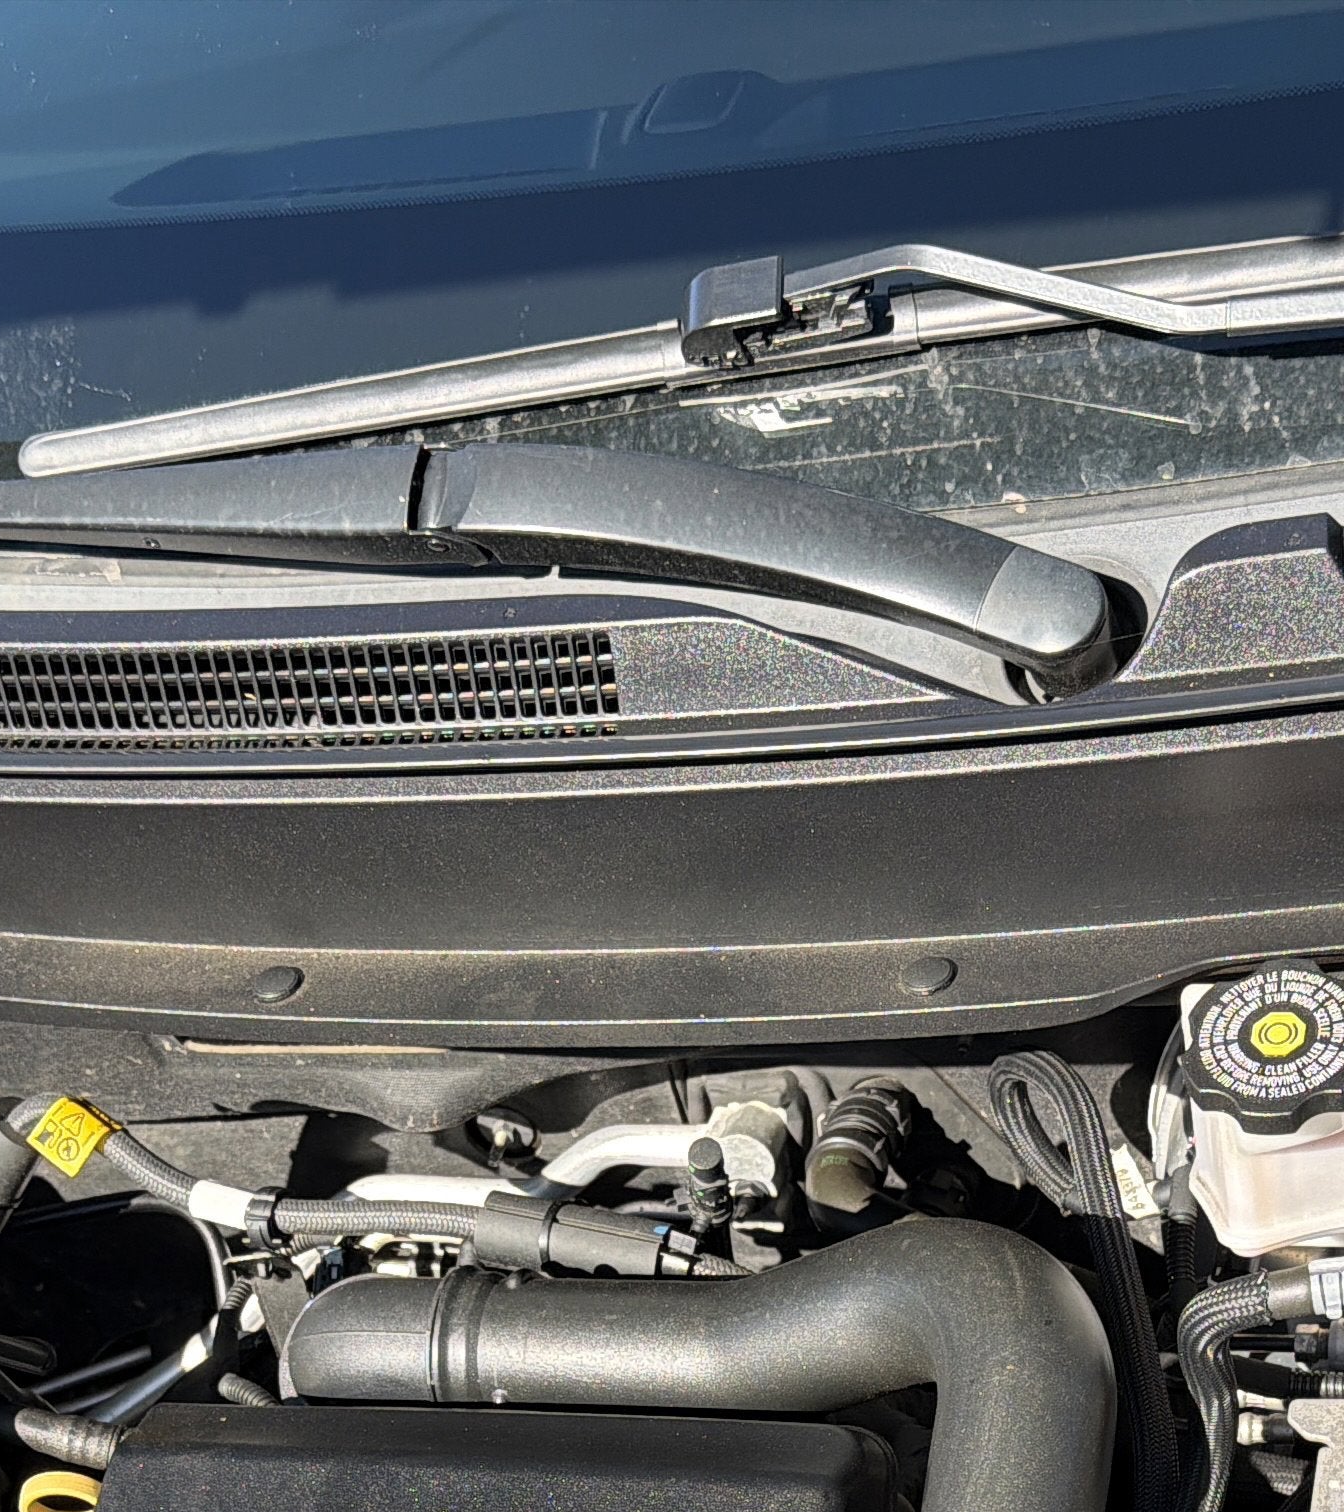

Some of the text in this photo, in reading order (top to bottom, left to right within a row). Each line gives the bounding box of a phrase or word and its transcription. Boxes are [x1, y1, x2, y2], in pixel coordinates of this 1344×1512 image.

[1220, 974, 1265, 1003] NETTOYER
[1266, 971, 1278, 983] LE
[1281, 969, 1326, 987] BOUCHON
[1242, 986, 1263, 1001] QUE
[1264, 982, 1278, 993] DU
[1281, 981, 1317, 997] LIQUIDE
[1314, 989, 1330, 1003] DE
[1323, 998, 1344, 1022] FREIN
[1226, 998, 1262, 1041] PROVENANT
[1265, 992, 1289, 1004] D'UN
[1290, 992, 1319, 1011] BIDON
[1213, 1045, 1229, 1060] CAP
[1265, 1062, 1298, 1076] CLEAN
[1296, 1042, 1327, 1069] FILLER
[1317, 1044, 1340, 1066] ONLY
[1209, 1066, 1235, 1088] FLUID
[1230, 1081, 1259, 1098] FROM
[1258, 1087, 1267, 1099] A
[1268, 1081, 1306, 1099] SEALED
[1220, 1058, 1253, 1084] BEFORE
[1302, 1061, 1324, 1078] USE
